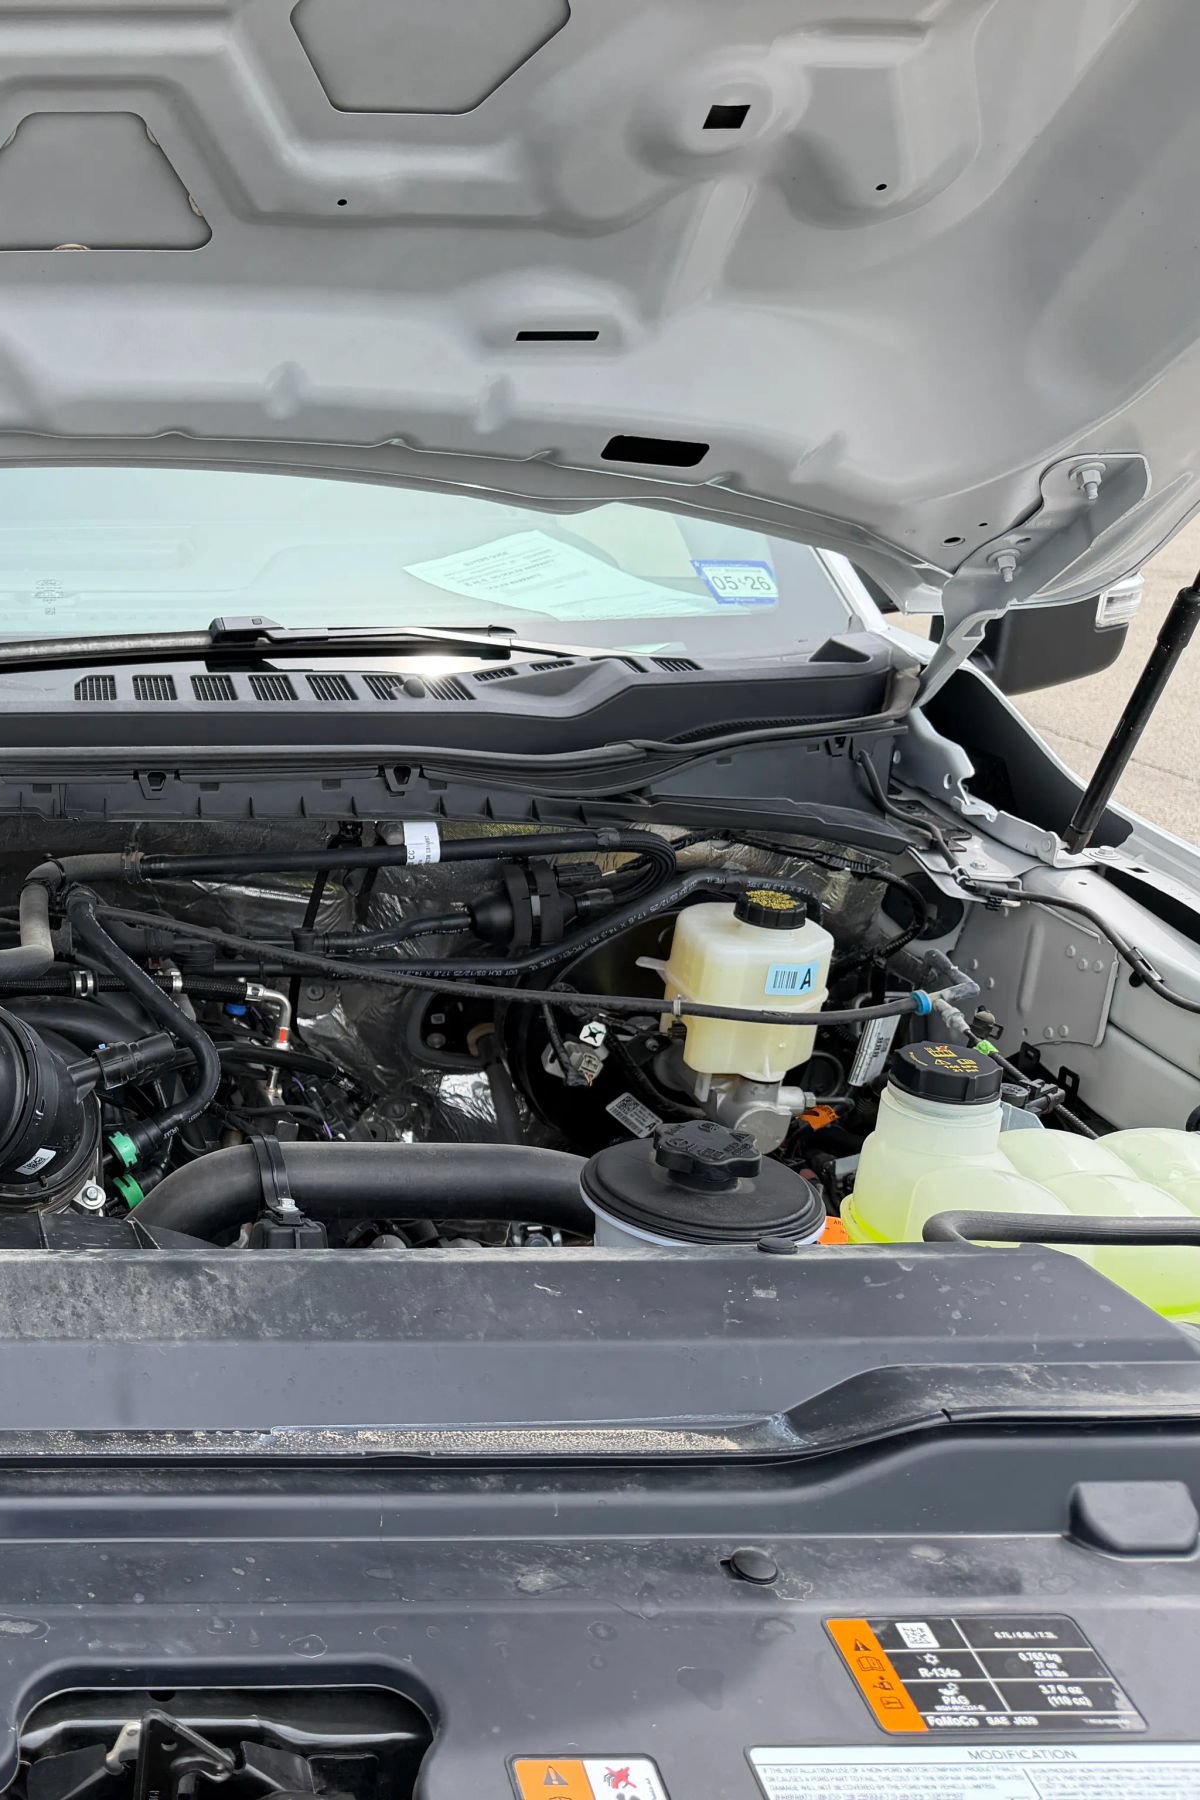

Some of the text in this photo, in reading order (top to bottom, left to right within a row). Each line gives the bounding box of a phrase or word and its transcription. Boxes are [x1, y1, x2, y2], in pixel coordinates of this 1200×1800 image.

[711, 575, 772, 591] 05 26
[799, 967, 812, 990] A
[1047, 1652, 1063, 1664] kg
[917, 1667, 962, 1678] R-134a
[1038, 1684, 1056, 1695] 3.7
[1067, 1686, 1084, 1695] oz
[941, 1695, 971, 1705] PAG
[1047, 1695, 1093, 1708] (110 cc)
[926, 1715, 980, 1727] FoMoCo
[985, 1716, 1012, 1726] SAE
[967, 1749, 1078, 1761] MODIFICATION
